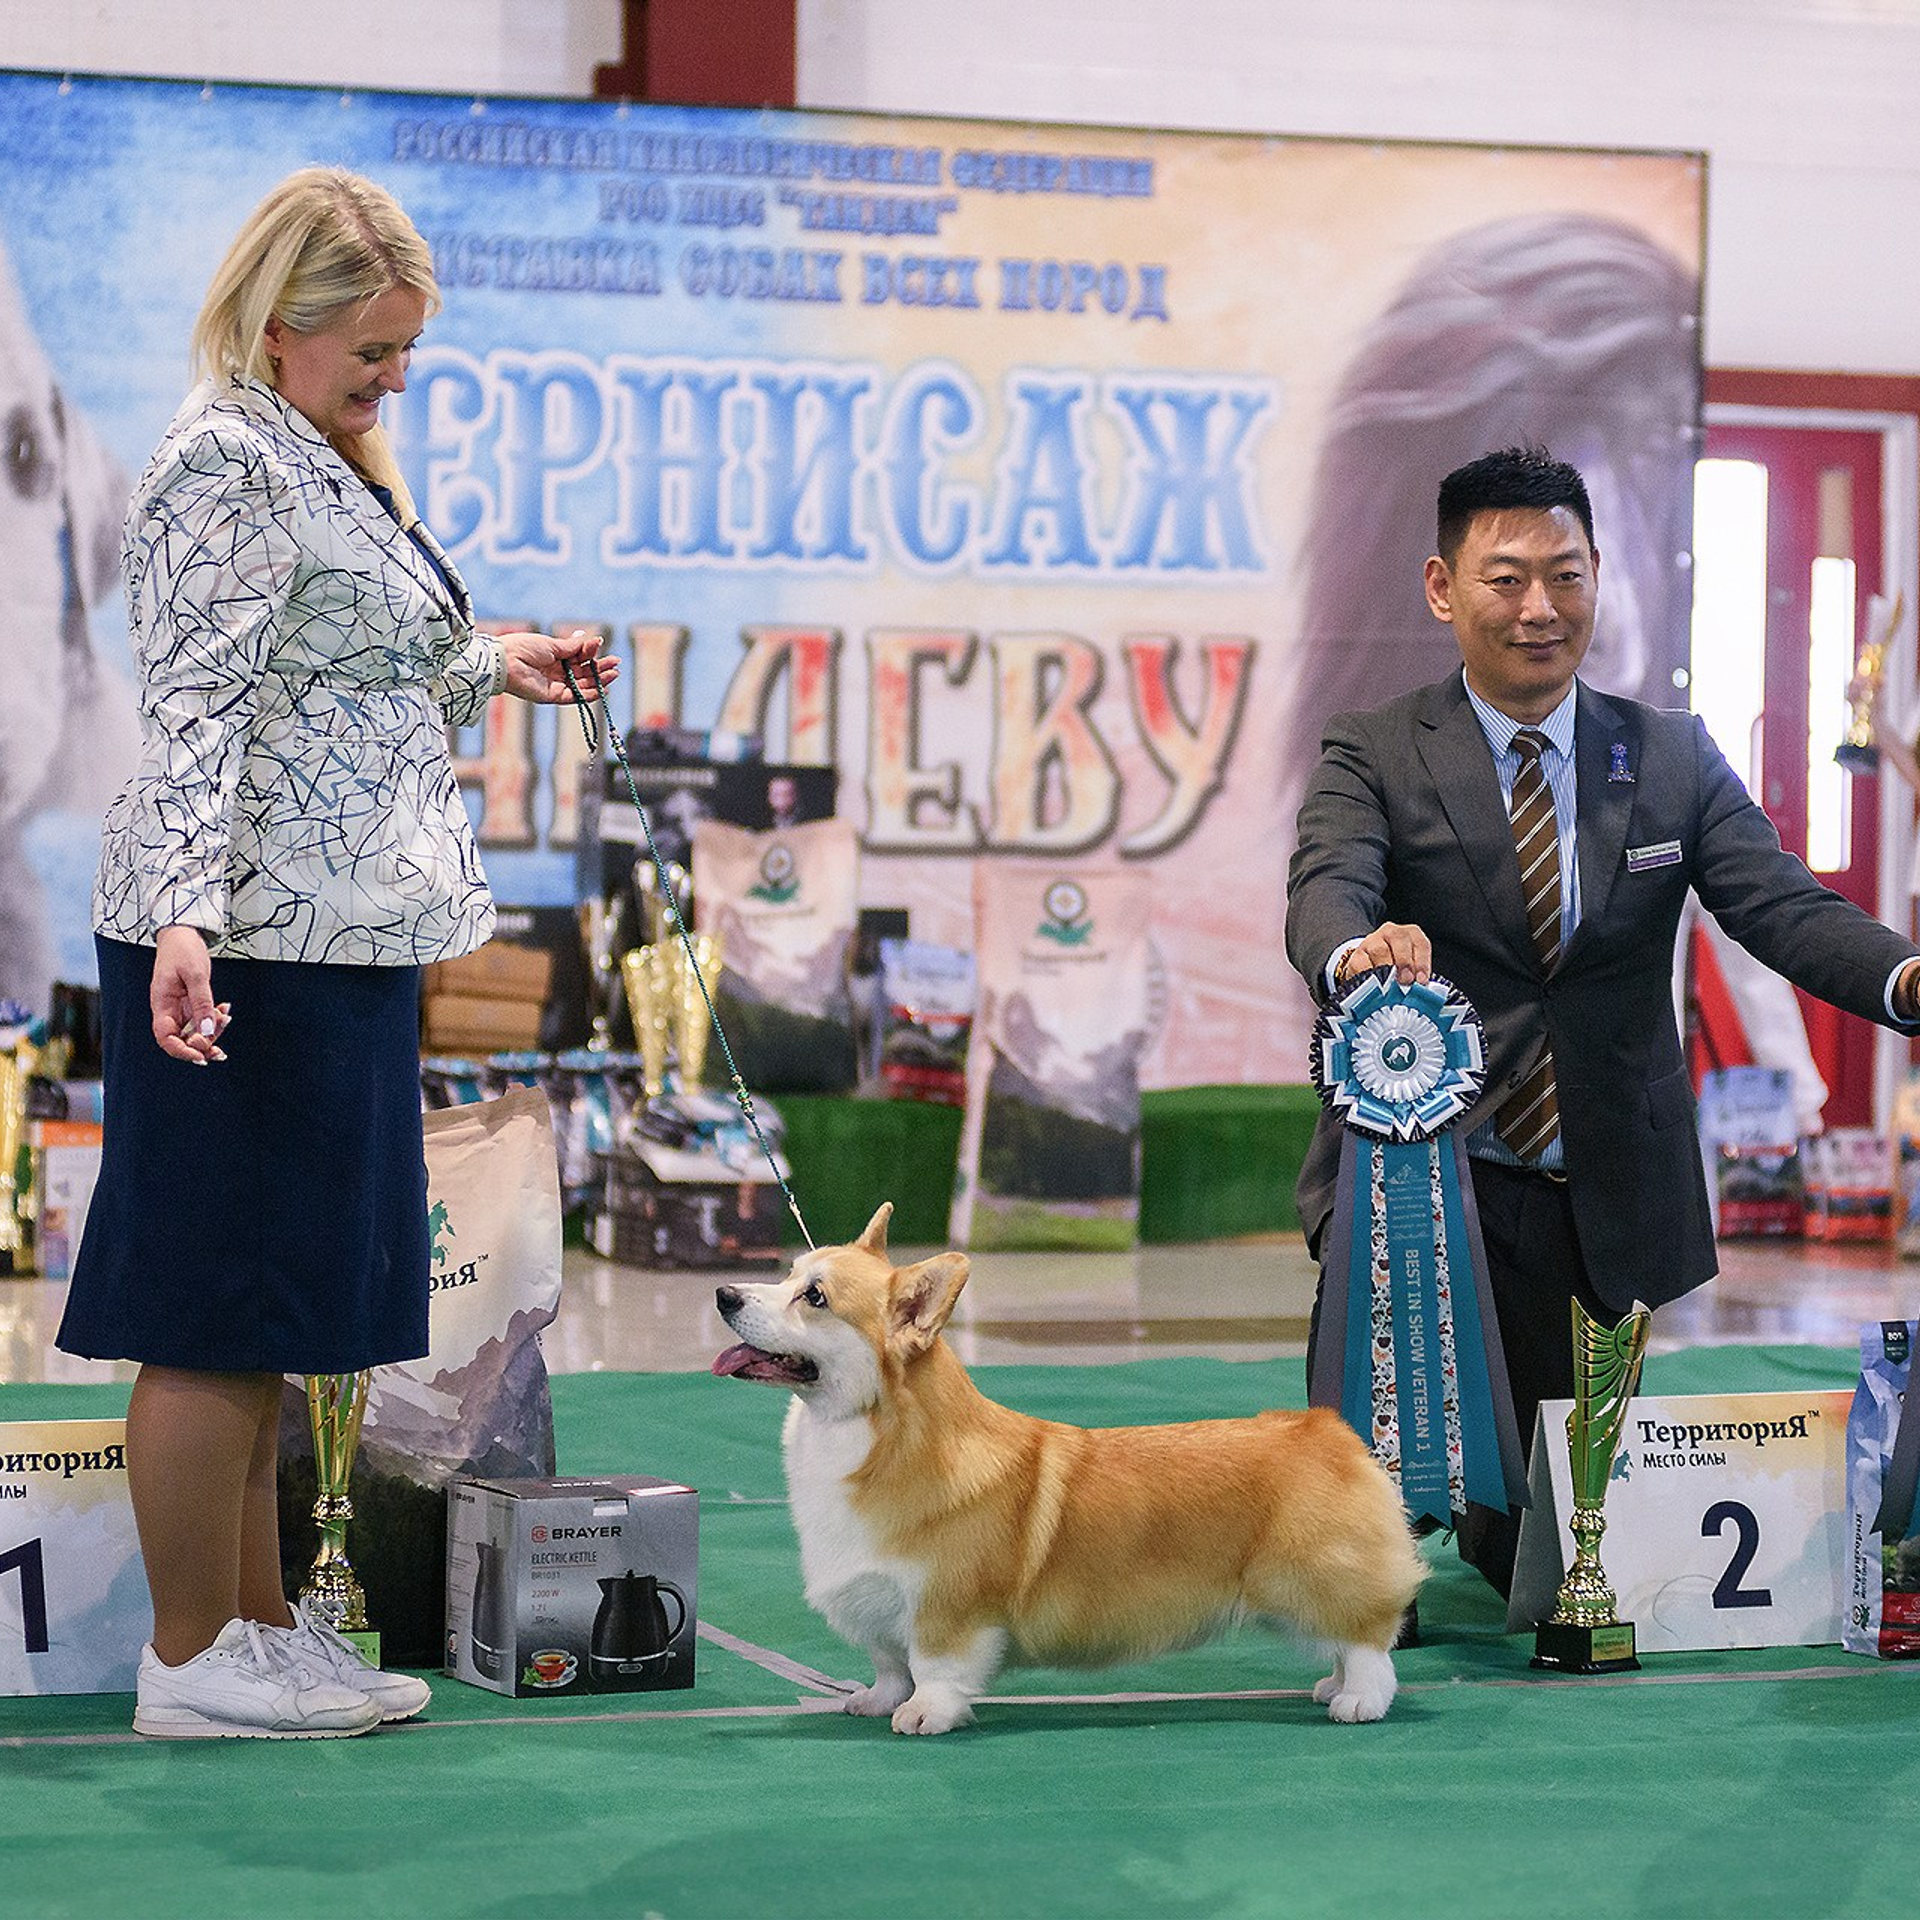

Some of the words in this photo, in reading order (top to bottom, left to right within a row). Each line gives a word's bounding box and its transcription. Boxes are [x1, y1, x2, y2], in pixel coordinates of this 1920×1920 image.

[679, 241, 842, 302] СОБАК
[862, 252, 982, 309] ВСЕХ
[998, 257, 1170, 323] ПОРОД
[401, 355, 1275, 577] ЕРНИСАЖ
[1405, 1249, 1421, 1287] BEST
[1407, 1291, 1422, 1310] IN
[1408, 1314, 1425, 1363] SHOW
[1412, 1366, 1430, 1438] VETERAN
[1416, 1442, 1431, 1452] 1
[552, 1526, 622, 1540] BRAYER
[1701, 1500, 1773, 1609] 2
[531, 1552, 568, 1565] ELECTRIC
[568, 1551, 597, 1563] KETTLE
[0, 1537, 49, 1653] 1
